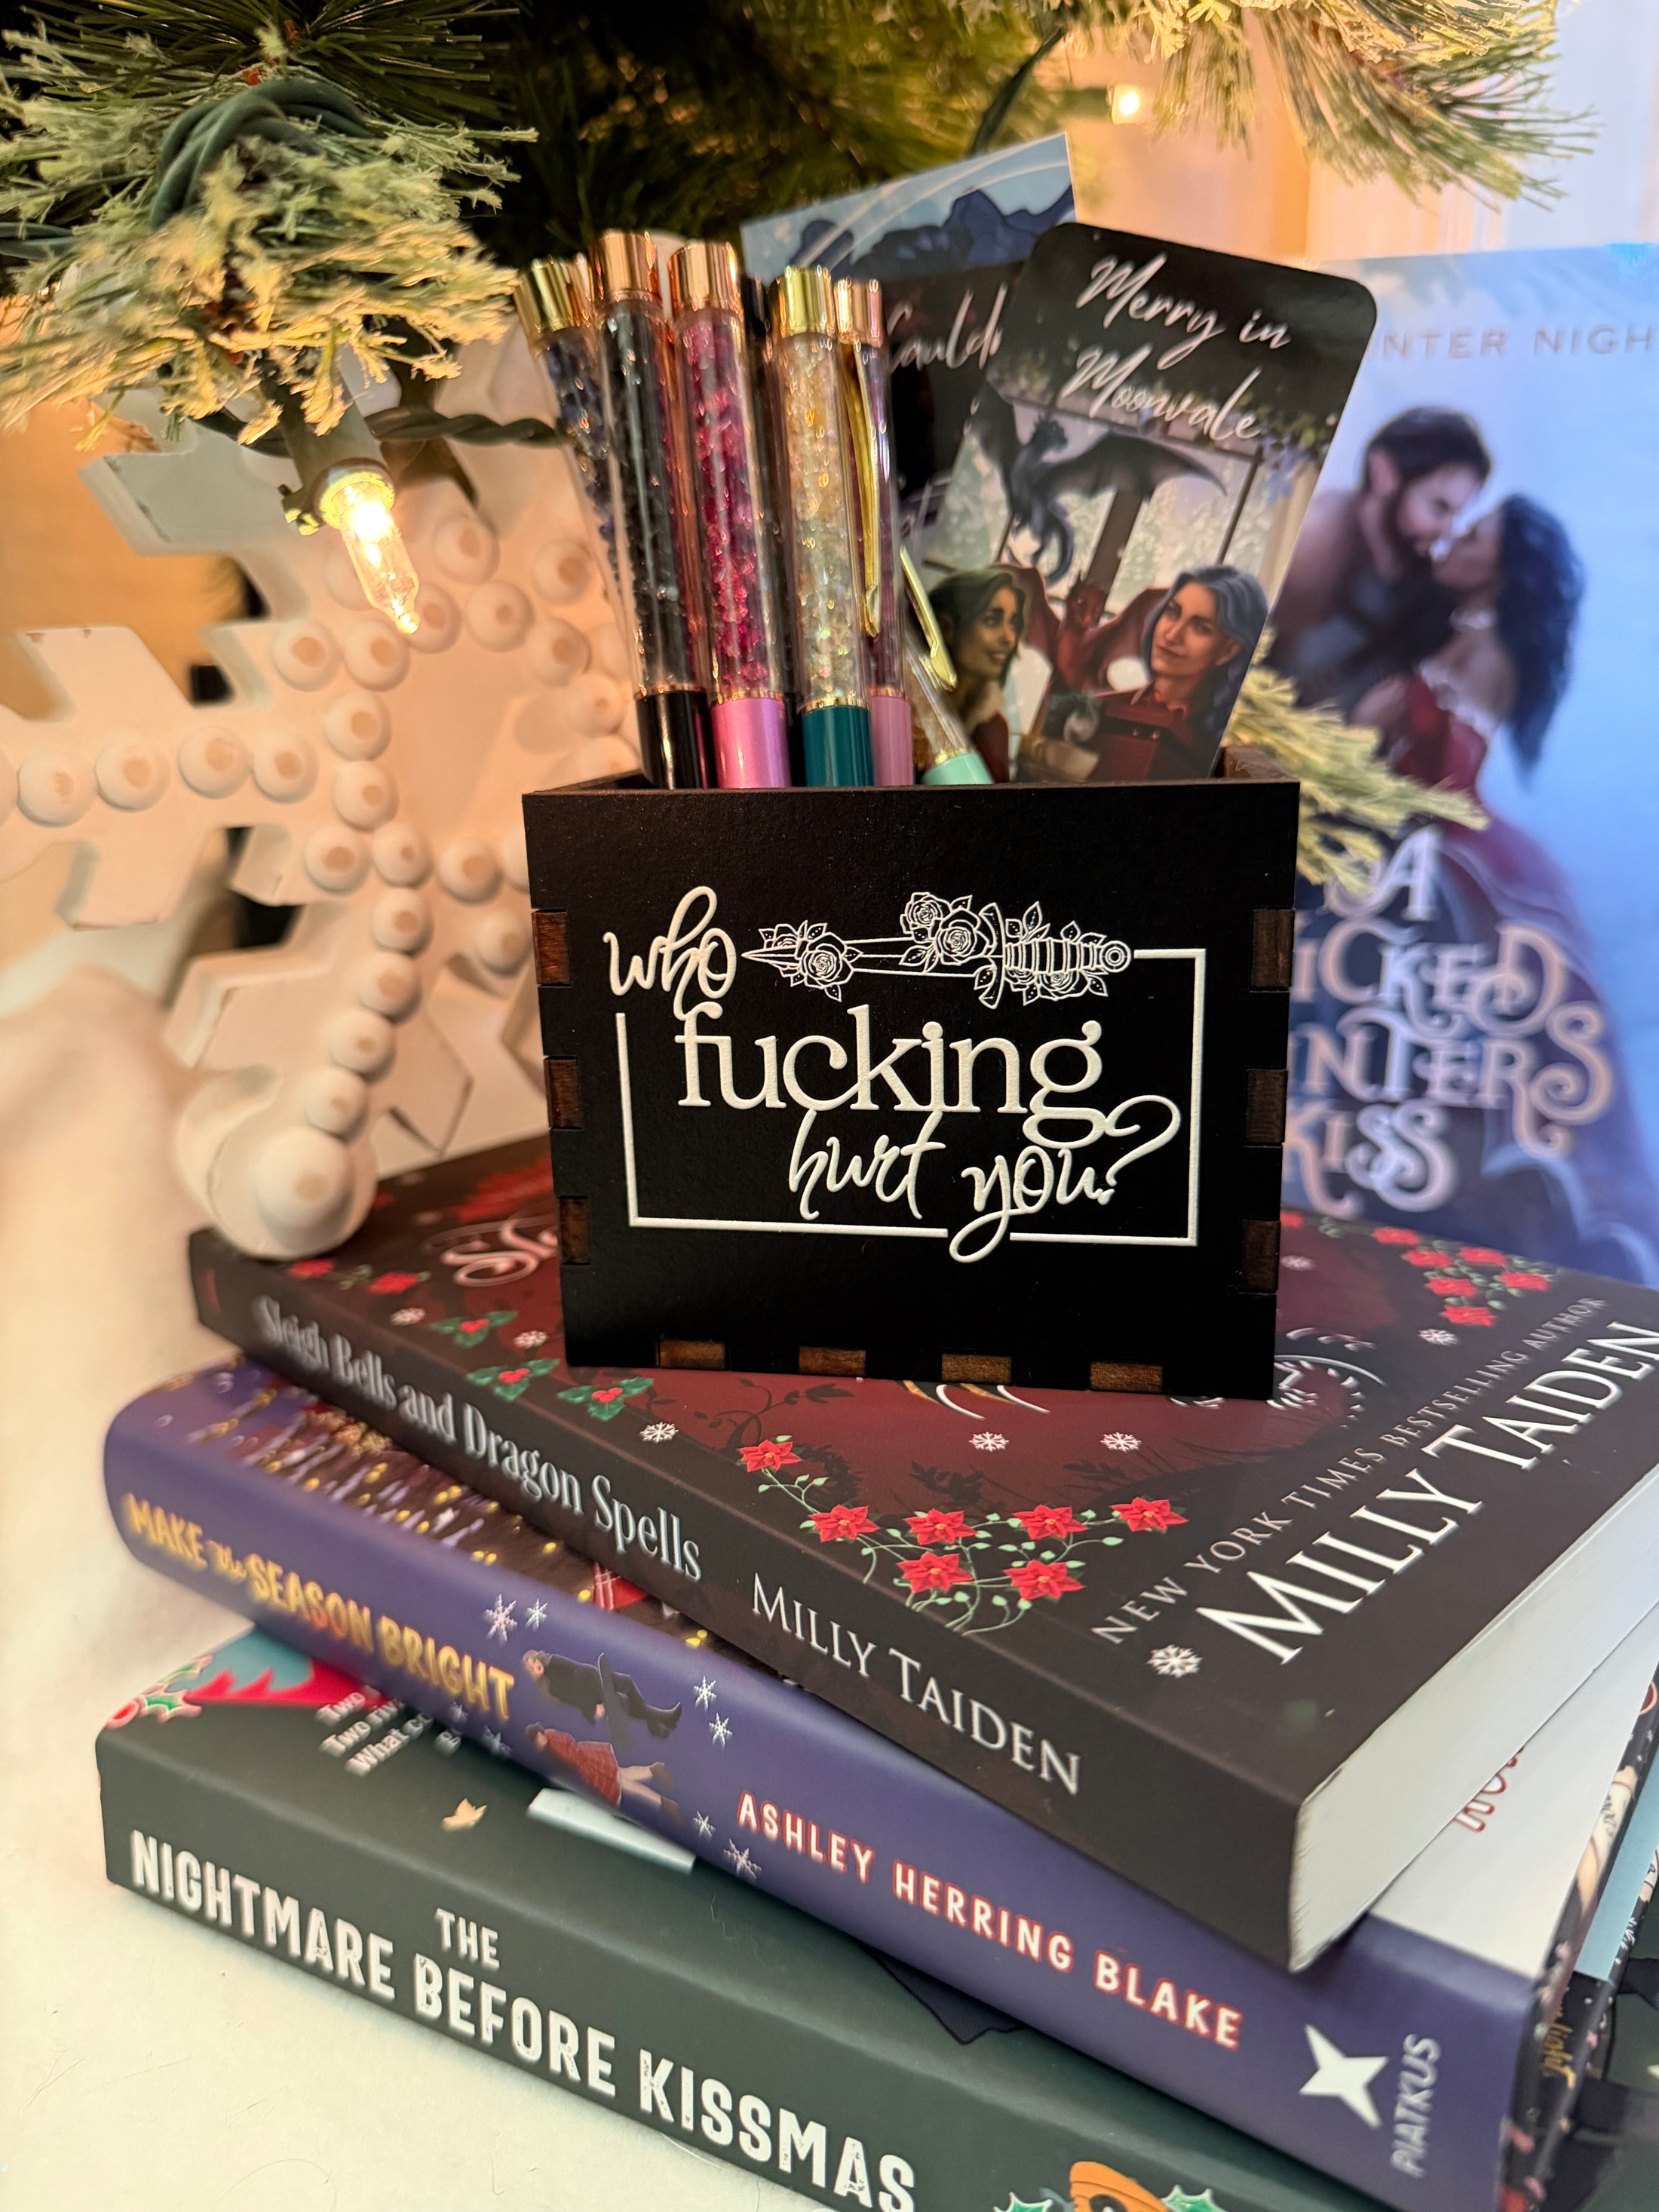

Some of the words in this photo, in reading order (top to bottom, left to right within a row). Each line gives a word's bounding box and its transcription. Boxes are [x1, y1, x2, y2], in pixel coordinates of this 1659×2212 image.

[886, 281, 1004, 375] Cauld
[1075, 252, 1227, 370] Merry
[1238, 308, 1292, 349] in
[1366, 326, 1507, 362] NTER
[1532, 321, 1656, 357] NIGH
[604, 885, 738, 1020] who
[1290, 915, 1567, 1039] ICKED
[674, 1003, 1109, 1149] fucking
[788, 1109, 946, 1220] hurt
[961, 1094, 1181, 1263] you?
[250, 1293, 332, 1373] Sleigh
[330, 1331, 397, 1410] Bells
[397, 1382, 456, 1444] and
[462, 1401, 585, 1515] Dragon
[591, 1473, 703, 1583] Spells
[751, 1572, 878, 1680] MILLY
[888, 1648, 1082, 1796] TAIDEN
[1090, 1575, 1189, 1646] NEW
[1184, 1511, 1294, 1575] YORK
[1280, 1446, 1388, 1511] TIMES
[1378, 1350, 1531, 1450] BESTSELLING
[1522, 1296, 1609, 1352] AUTHOR
[1195, 1467, 1485, 1665] MILLY
[1420, 1320, 1659, 1471] TAIDEN
[122, 1493, 209, 1571] MAKE
[244, 1552, 376, 1653] SEASON
[376, 1615, 517, 1723] BRIGHT
[434, 1907, 501, 1972] THE
[736, 1790, 875, 1884] ASHLEY
[892, 1861, 1075, 1974] HERRING
[1093, 1950, 1243, 2049] BLAKE
[129, 1829, 397, 2001] NIGHTMARE
[412, 1952, 618, 2099] BEFORE
[637, 2048, 917, 2212] KISSMAS
[1389, 2033, 1442, 2180] PIATKUS
